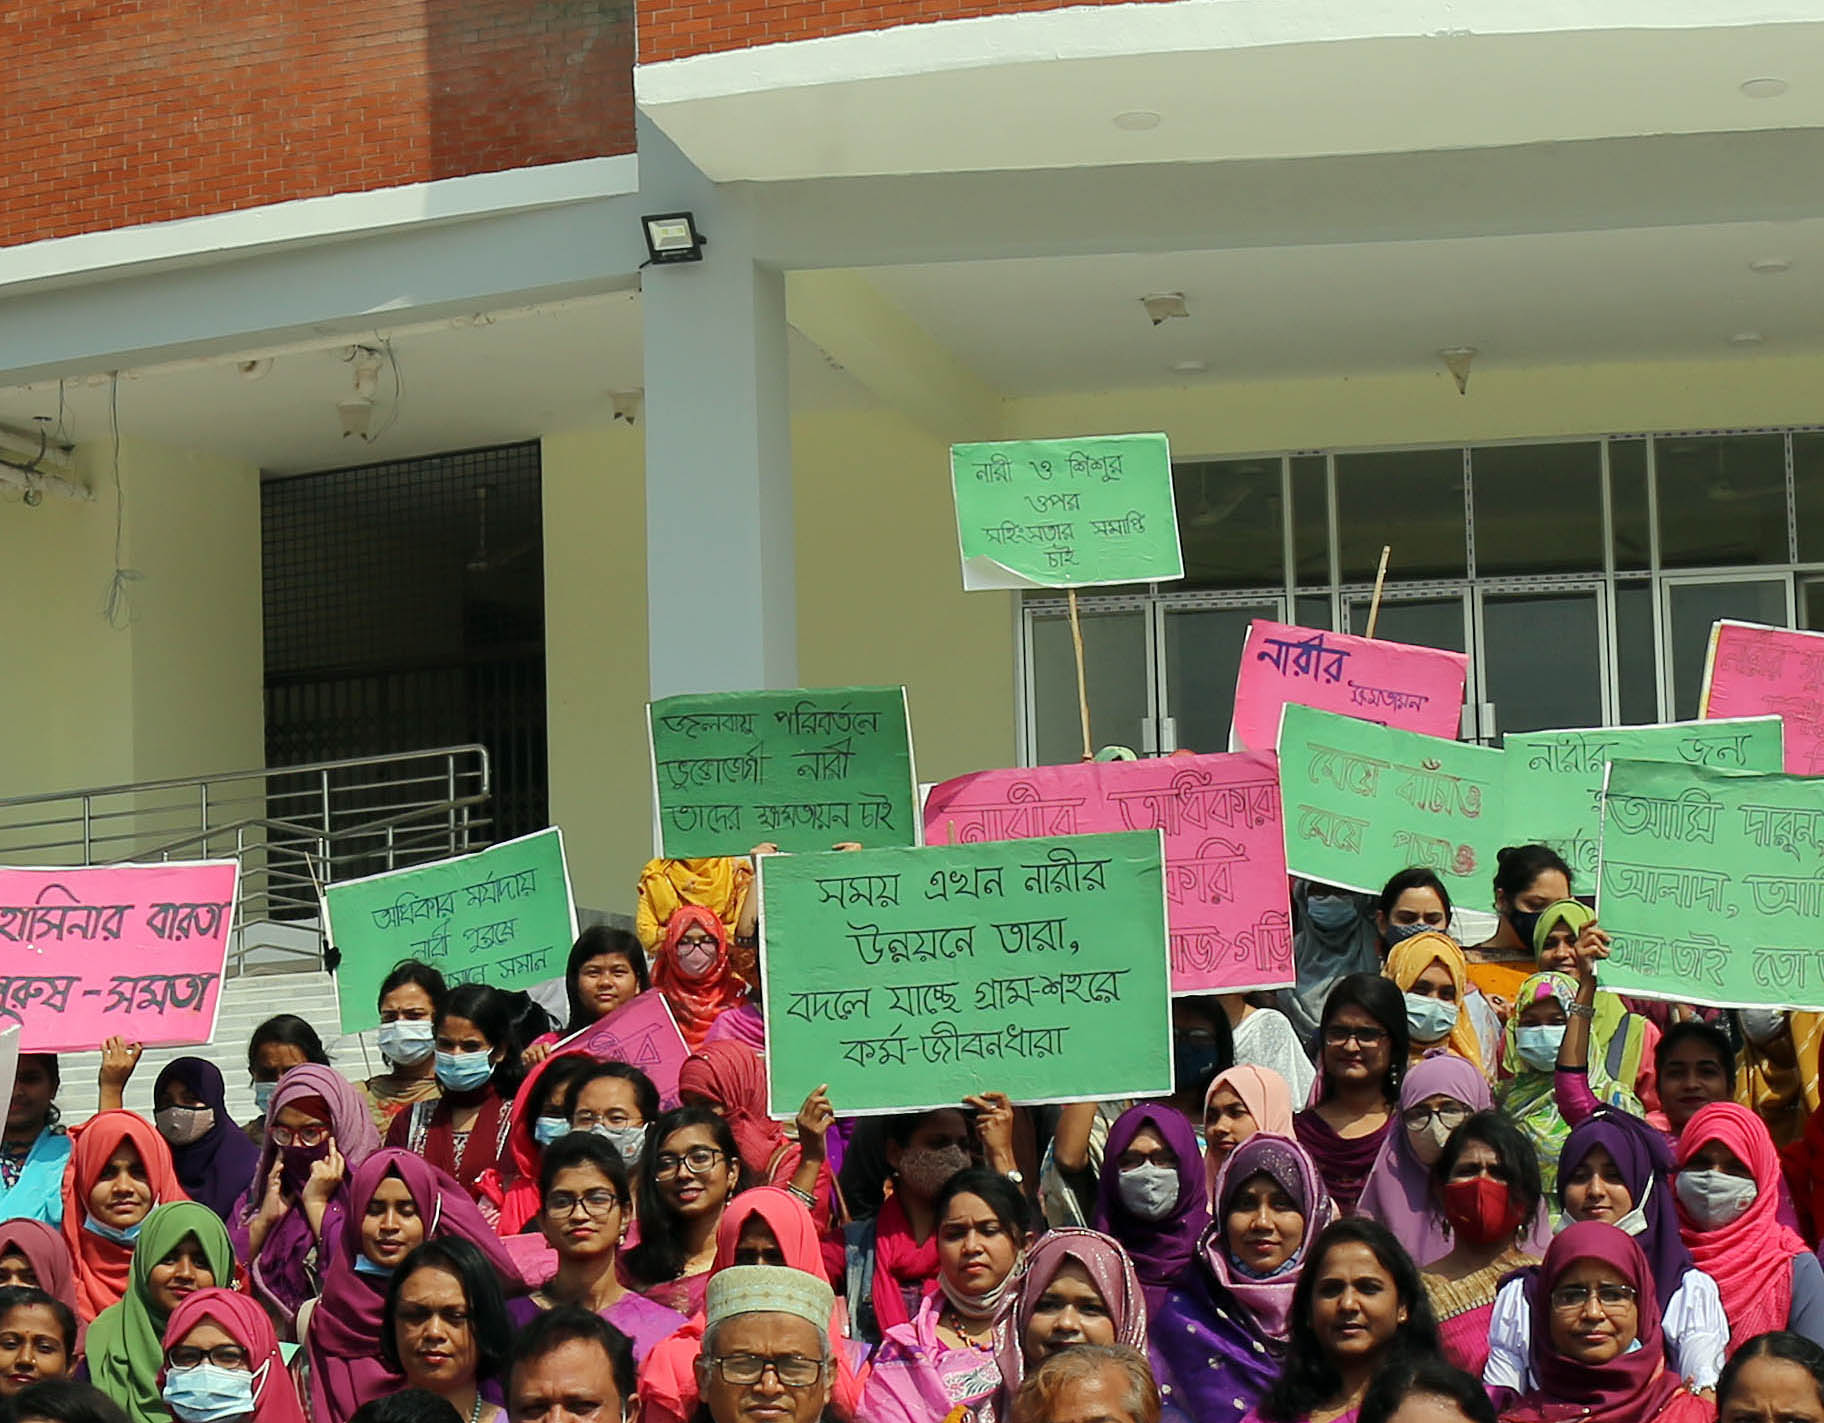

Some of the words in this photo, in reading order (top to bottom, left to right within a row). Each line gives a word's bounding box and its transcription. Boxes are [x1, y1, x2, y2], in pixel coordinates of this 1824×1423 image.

[972, 453, 1014, 484] নারী
[1029, 459, 1053, 481] ও
[1257, 633, 1351, 683] নারীর
[792, 737, 856, 781] নারী
[1677, 735, 1752, 766] জন্য
[663, 804, 744, 834] তাদের
[857, 793, 895, 830] চাই
[1607, 787, 1725, 844] আমি
[816, 873, 901, 908] সময়
[925, 866, 1003, 902] এখন
[1021, 848, 1112, 894] নারীর
[146, 901, 232, 942] বারতা
[847, 921, 976, 964] উন্নয়নে
[990, 918, 1079, 956] তারা,
[787, 988, 870, 1023] বদলে
[886, 982, 962, 1018] যাচ্ছে
